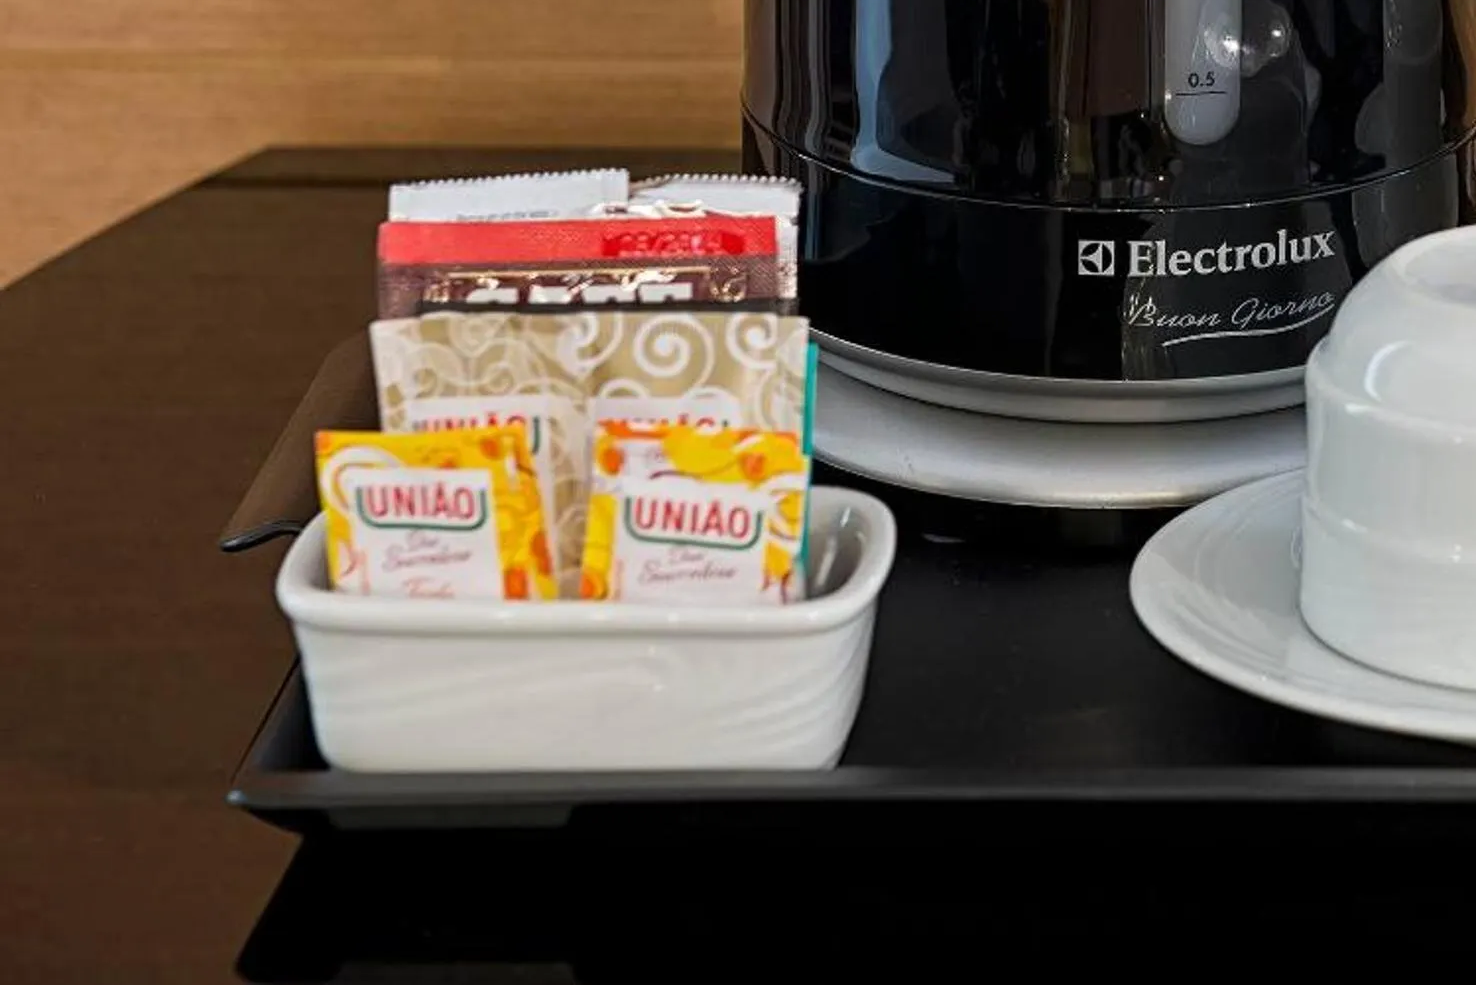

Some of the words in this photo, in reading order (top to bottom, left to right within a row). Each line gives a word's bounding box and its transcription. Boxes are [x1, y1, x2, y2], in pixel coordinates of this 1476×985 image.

[1188, 71, 1215, 88] 0.5
[1127, 228, 1336, 278] Electrolux
[1124, 291, 1222, 328] Buon
[1230, 291, 1335, 330] Giorno
